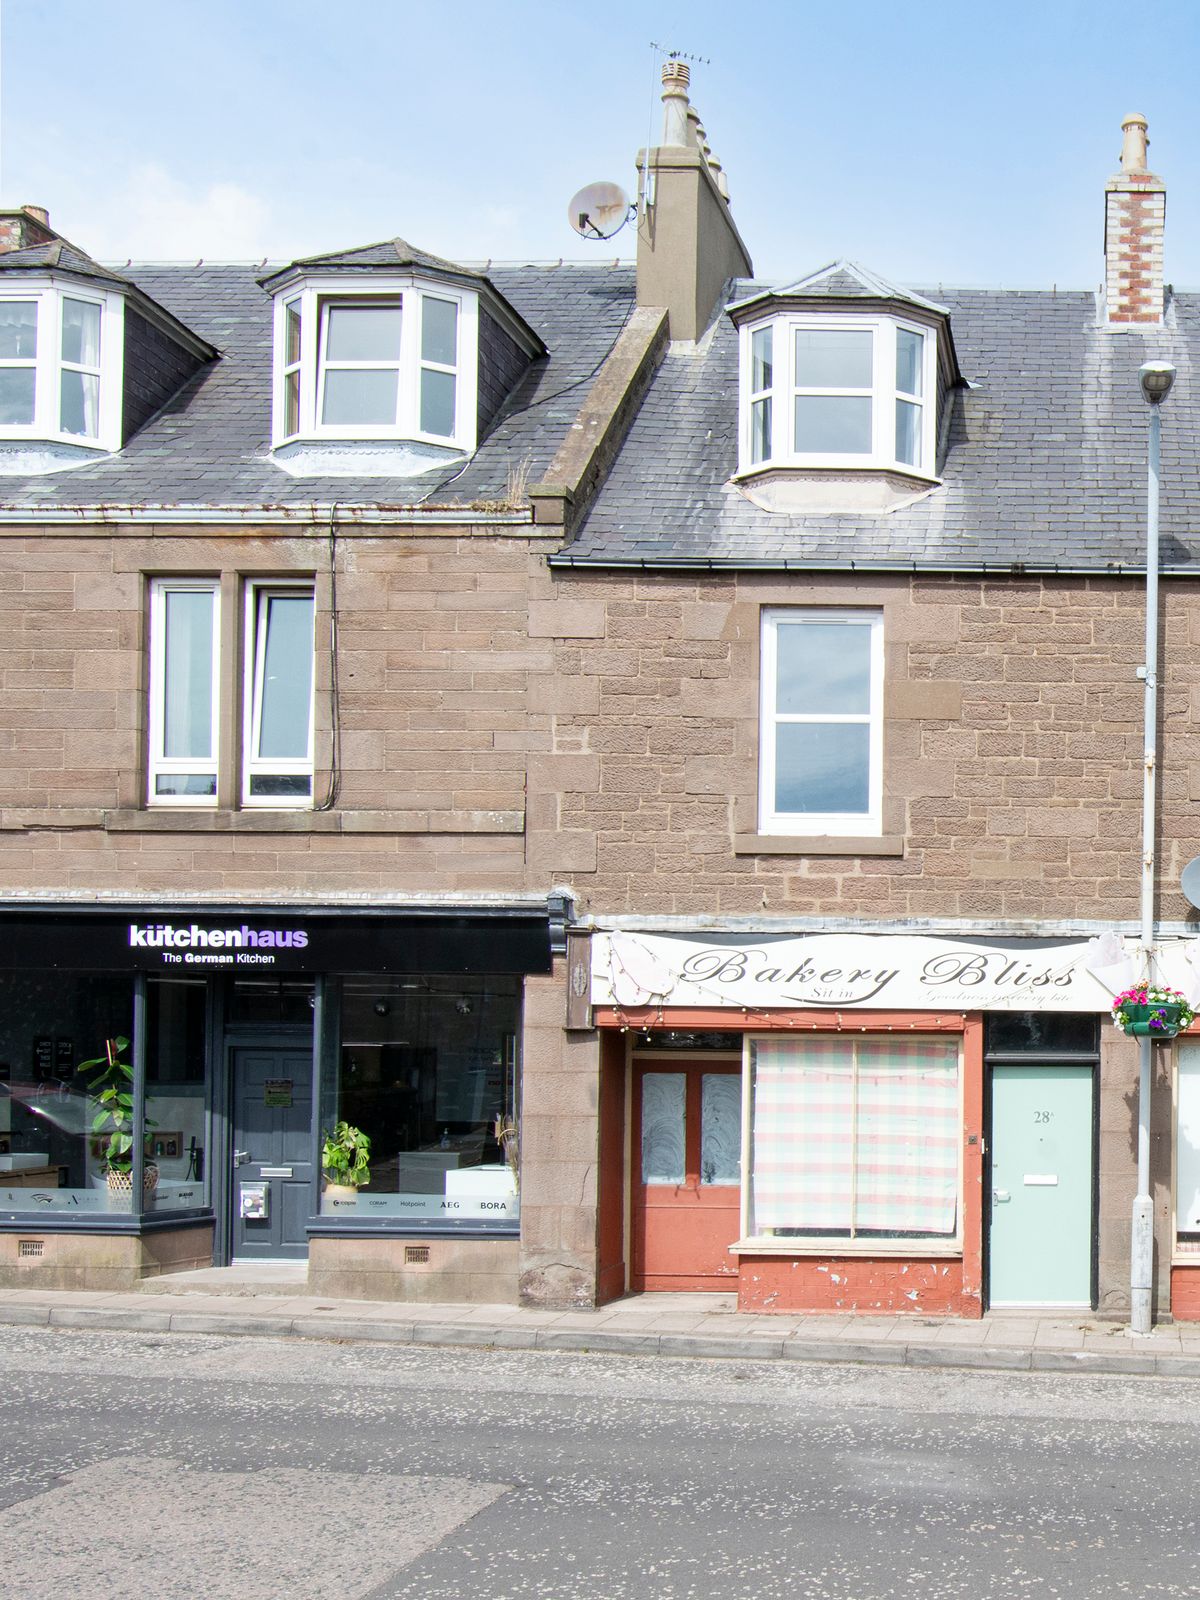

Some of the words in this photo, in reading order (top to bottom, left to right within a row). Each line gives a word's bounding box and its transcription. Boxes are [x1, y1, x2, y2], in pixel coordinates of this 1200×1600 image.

[129, 925, 309, 947] kütchenhaus
[163, 953, 182, 963] The
[185, 953, 233, 963] German
[237, 953, 275, 963] Kitchen
[679, 949, 900, 1005] Bakery
[919, 952, 1075, 987] Bliss
[810, 986, 833, 998] Sit
[839, 988, 854, 998] in
[400, 1200, 426, 1208] Hotpoint
[440, 1201, 460, 1209] AEG
[481, 1202, 507, 1210] BORA
